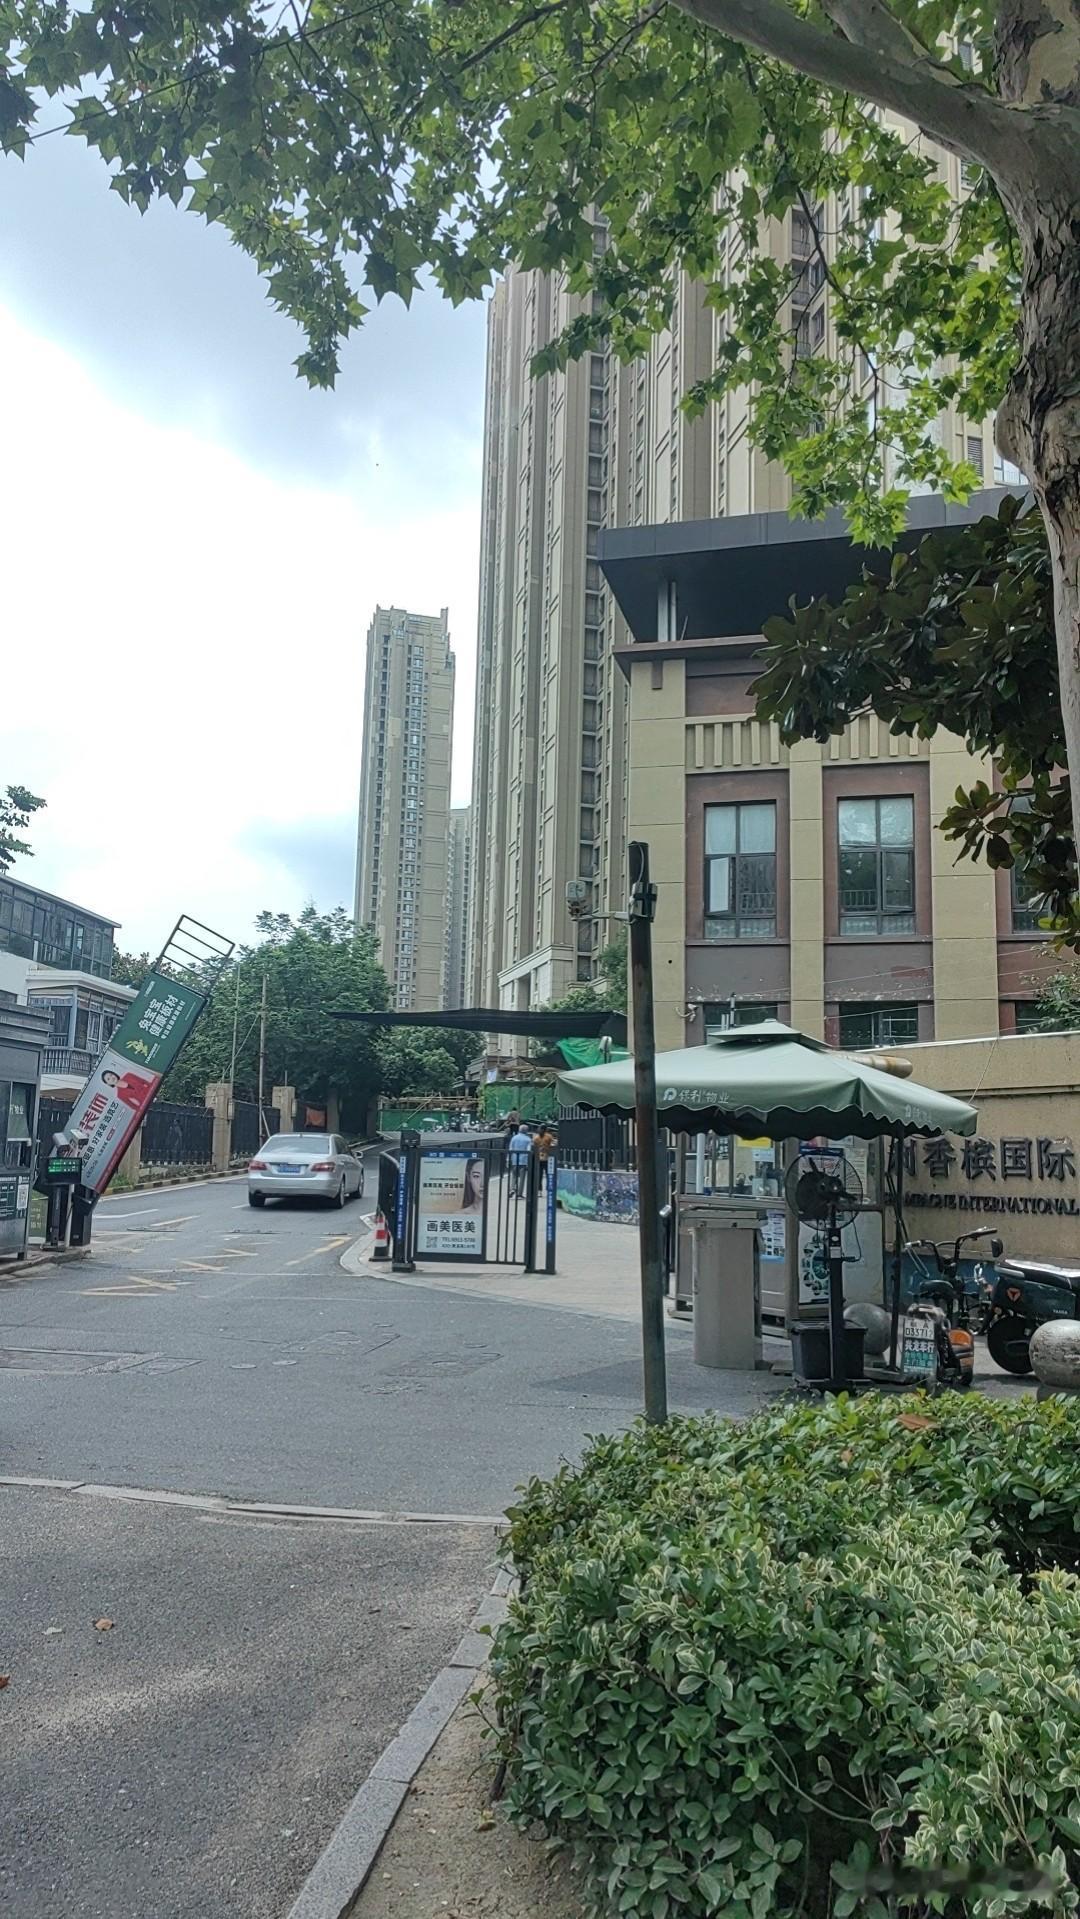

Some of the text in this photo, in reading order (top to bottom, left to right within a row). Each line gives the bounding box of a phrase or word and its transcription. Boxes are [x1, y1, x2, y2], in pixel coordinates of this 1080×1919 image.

[138, 998, 163, 1031] 兔宝宝
[148, 994, 179, 1037] 健康板材
[426, 1220, 475, 1233] 画美医美
